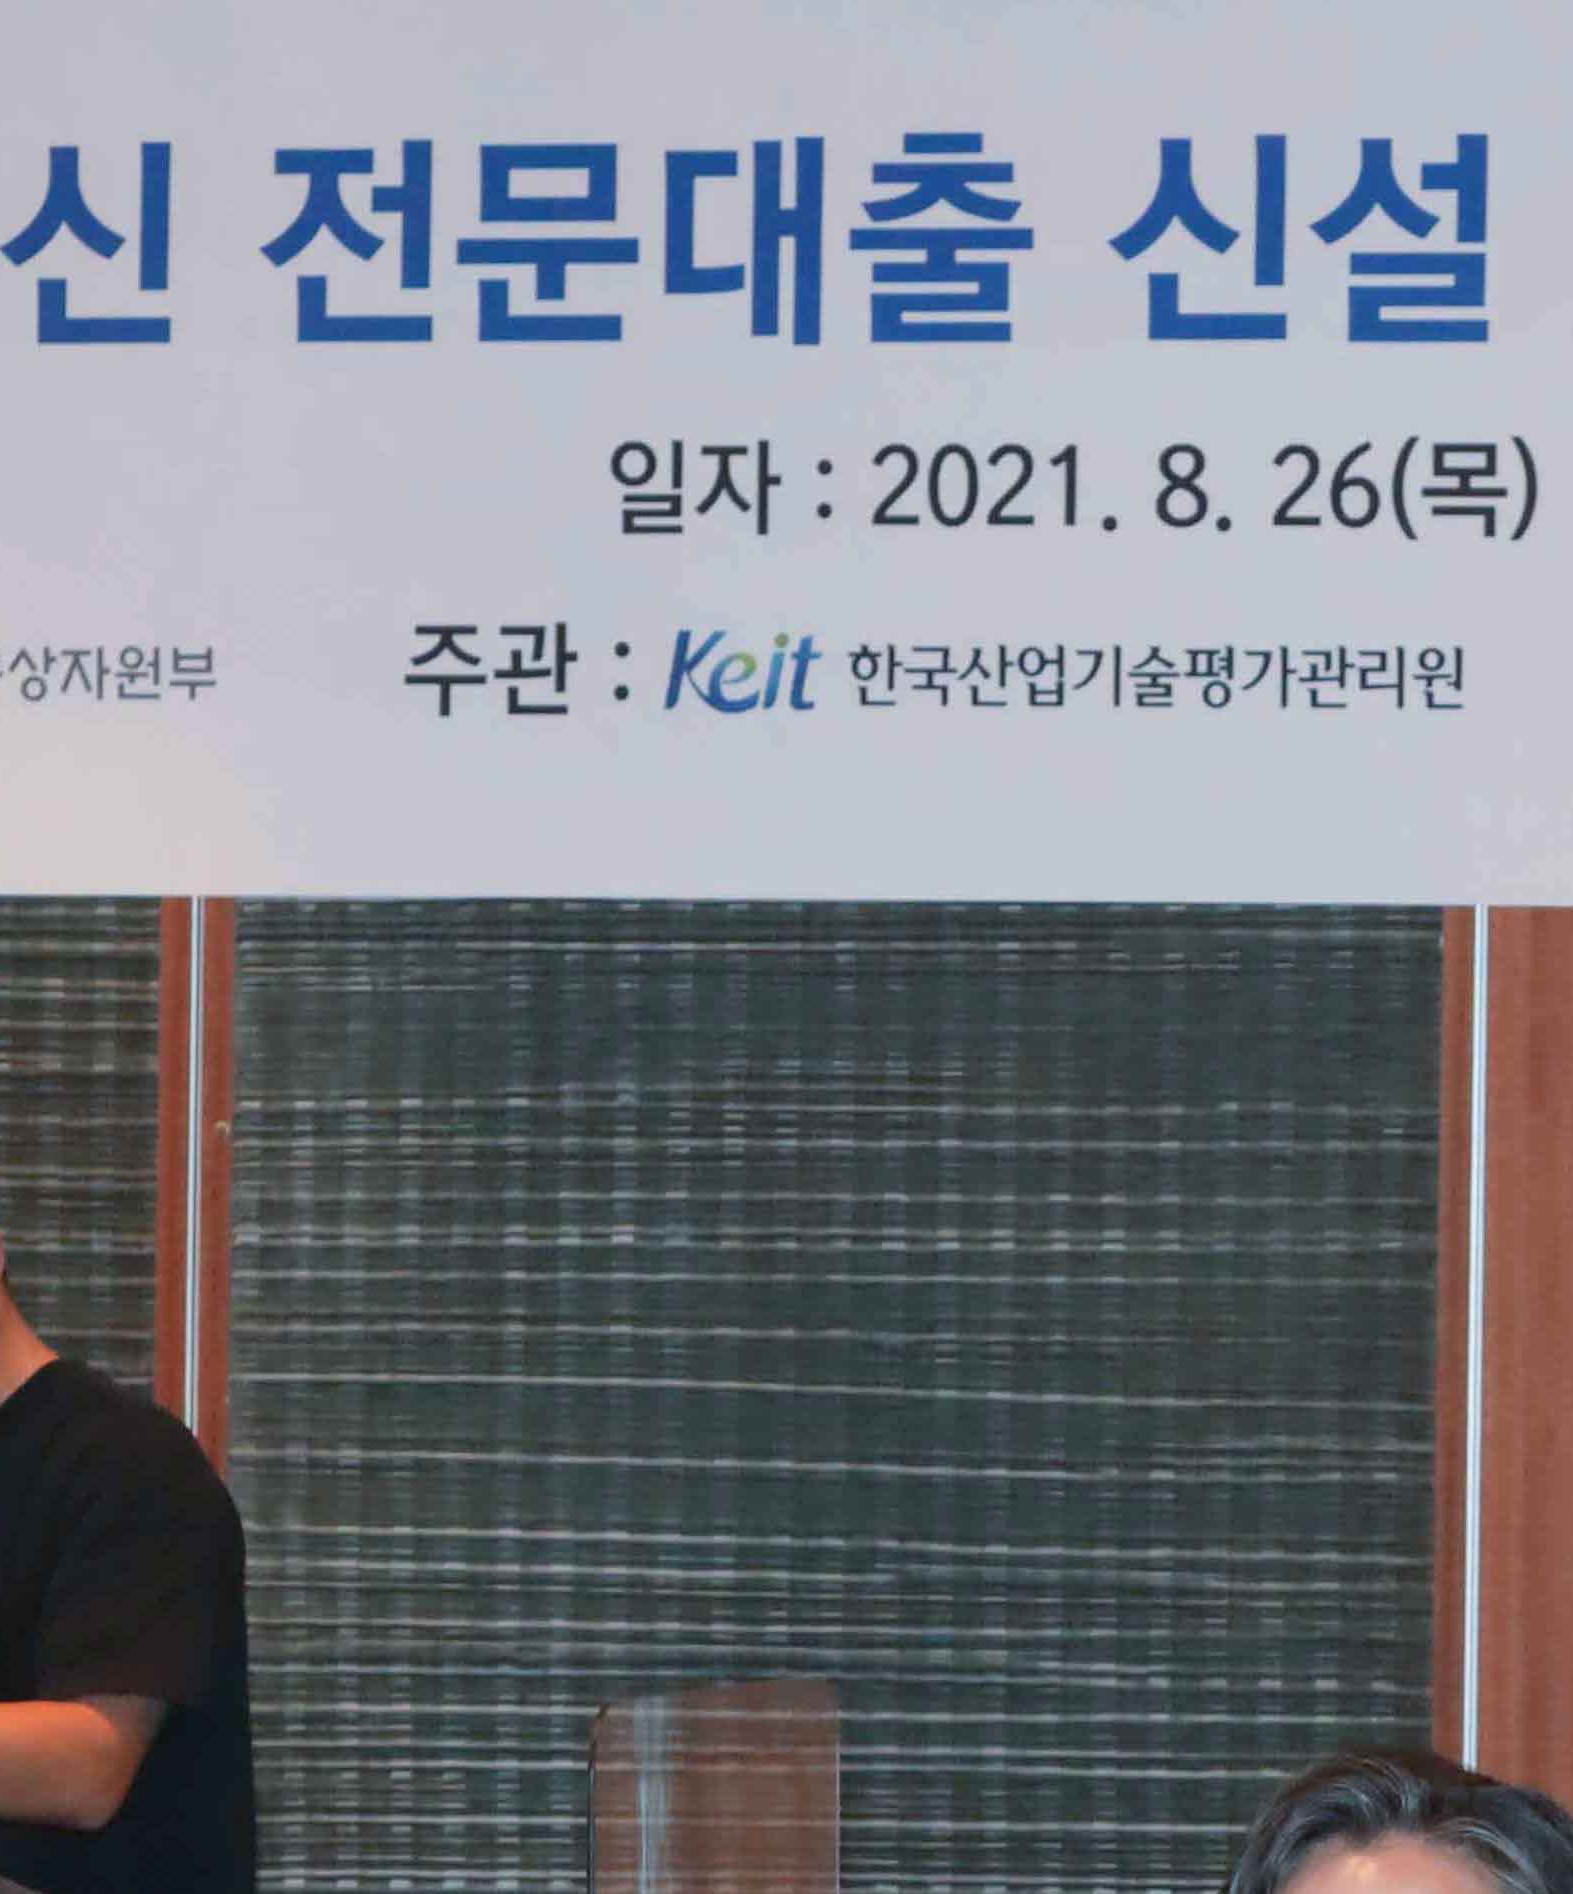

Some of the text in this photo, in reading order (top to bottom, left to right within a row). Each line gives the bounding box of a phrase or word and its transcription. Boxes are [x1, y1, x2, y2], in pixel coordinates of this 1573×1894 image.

[261, 133, 1034, 345] 전문대출
[1109, 134, 1488, 342] 신설
[611, 440, 781, 535] 일자
[872, 444, 1117, 531] 2021.
[1156, 444, 1231, 532] 8.
[1273, 437, 1537, 540] 26(목)
[405, 623, 578, 716] 주관
[665, 630, 821, 714] Keit
[849, 645, 1463, 709] 한국산업기술평가관리원
